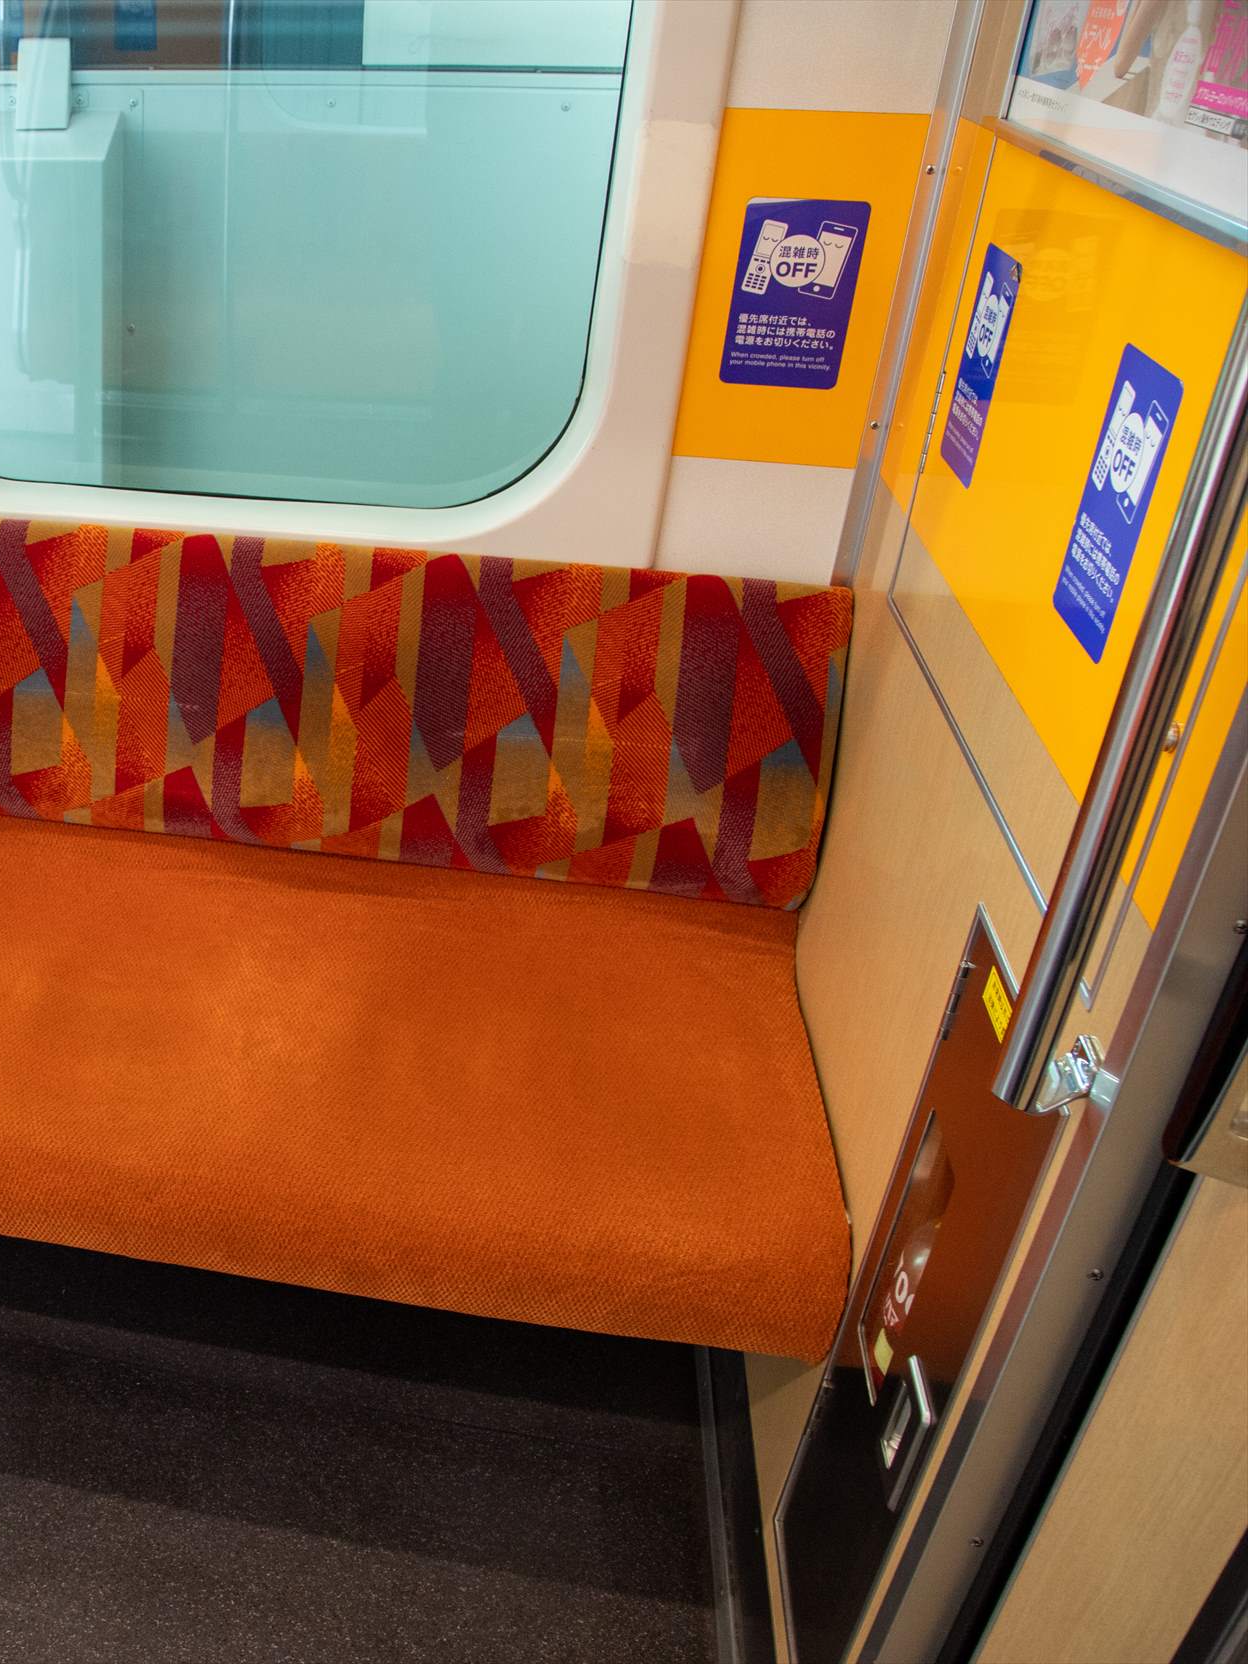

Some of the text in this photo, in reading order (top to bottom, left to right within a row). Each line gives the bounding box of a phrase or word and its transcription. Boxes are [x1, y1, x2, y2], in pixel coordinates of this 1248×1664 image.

[779, 245, 819, 259] 混雑時
[776, 261, 817, 278] OFF
[738, 313, 812, 326] 優先席付近では、
[736, 324, 836, 339] 混雑時には携帯電話の
[979, 323, 994, 348] OFF
[734, 335, 834, 350] 電源をお切りください。
[1113, 448, 1137, 482] OFF
